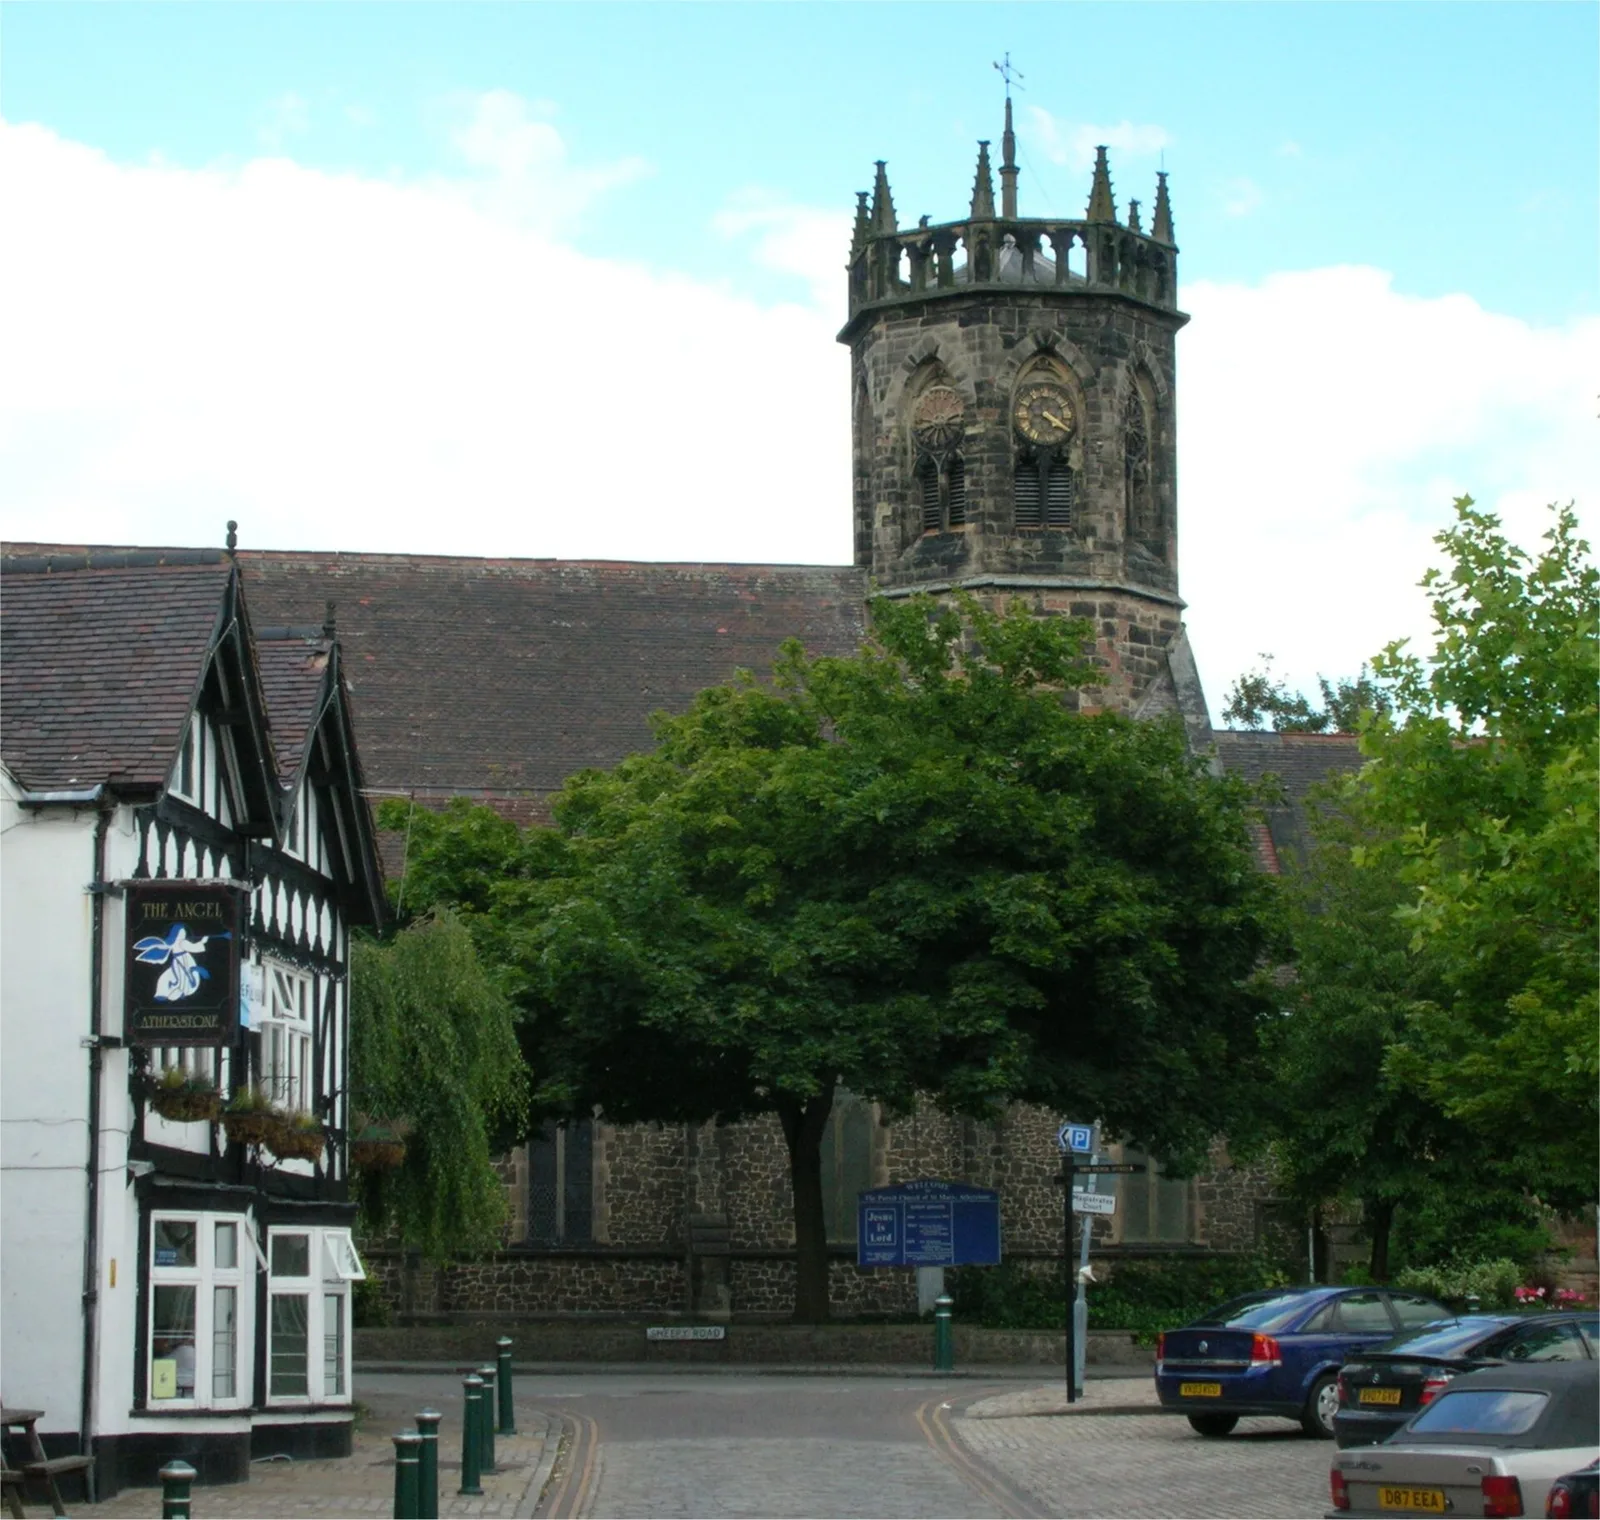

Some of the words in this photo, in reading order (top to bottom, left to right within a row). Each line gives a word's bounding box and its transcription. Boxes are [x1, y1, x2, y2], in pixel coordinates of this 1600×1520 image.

[142, 903, 168, 917] THE
[175, 903, 222, 918] ANGEL
[141, 1014, 218, 1028] ATHERSTONE
[1075, 1131, 1085, 1145] P
[868, 1212, 893, 1222] Jesus
[870, 1232, 892, 1242] Lord
[692, 1328, 720, 1338] ROAD
[1384, 1489, 1409, 1505] D87
[1413, 1491, 1439, 1508] EEA
